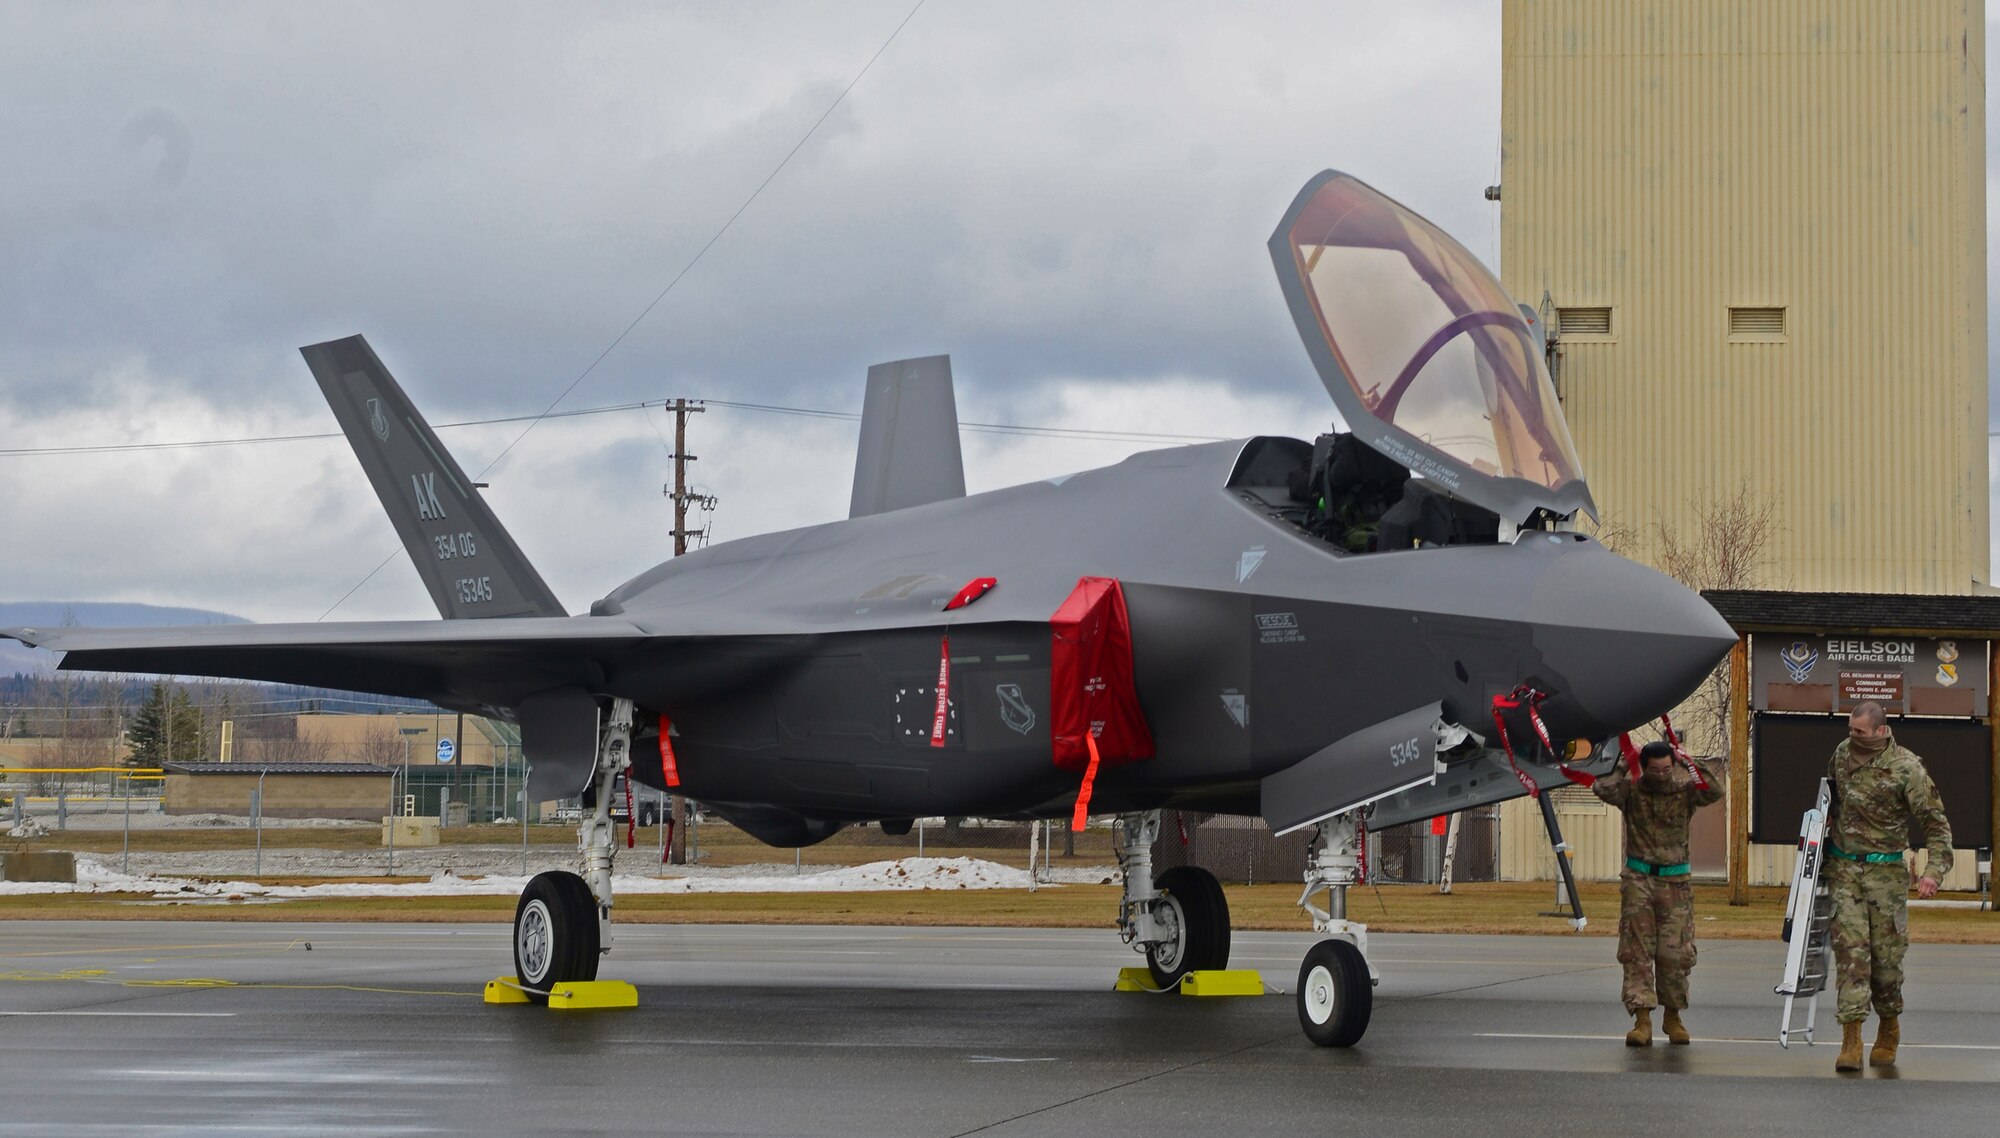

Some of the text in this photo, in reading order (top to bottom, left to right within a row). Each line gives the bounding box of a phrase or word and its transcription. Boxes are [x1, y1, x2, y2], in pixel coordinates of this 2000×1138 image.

[1421, 465, 1441, 480] CANOPY
[1441, 474, 1461, 489] FRAME
[1425, 458, 1437, 468] CUT
[1437, 464, 1459, 479] CANOPY
[411, 472, 446, 520] AK
[435, 531, 476, 560] 354 OG
[462, 576, 492, 603] 5345
[1260, 615, 1292, 626] RESCUE
[1827, 640, 1915, 654] EIELSON
[1848, 654, 1884, 662] FORCE
[938, 688, 946, 713] BEFORE
[933, 716, 943, 738] FLIGHT
[1390, 738, 1420, 767] 5345
